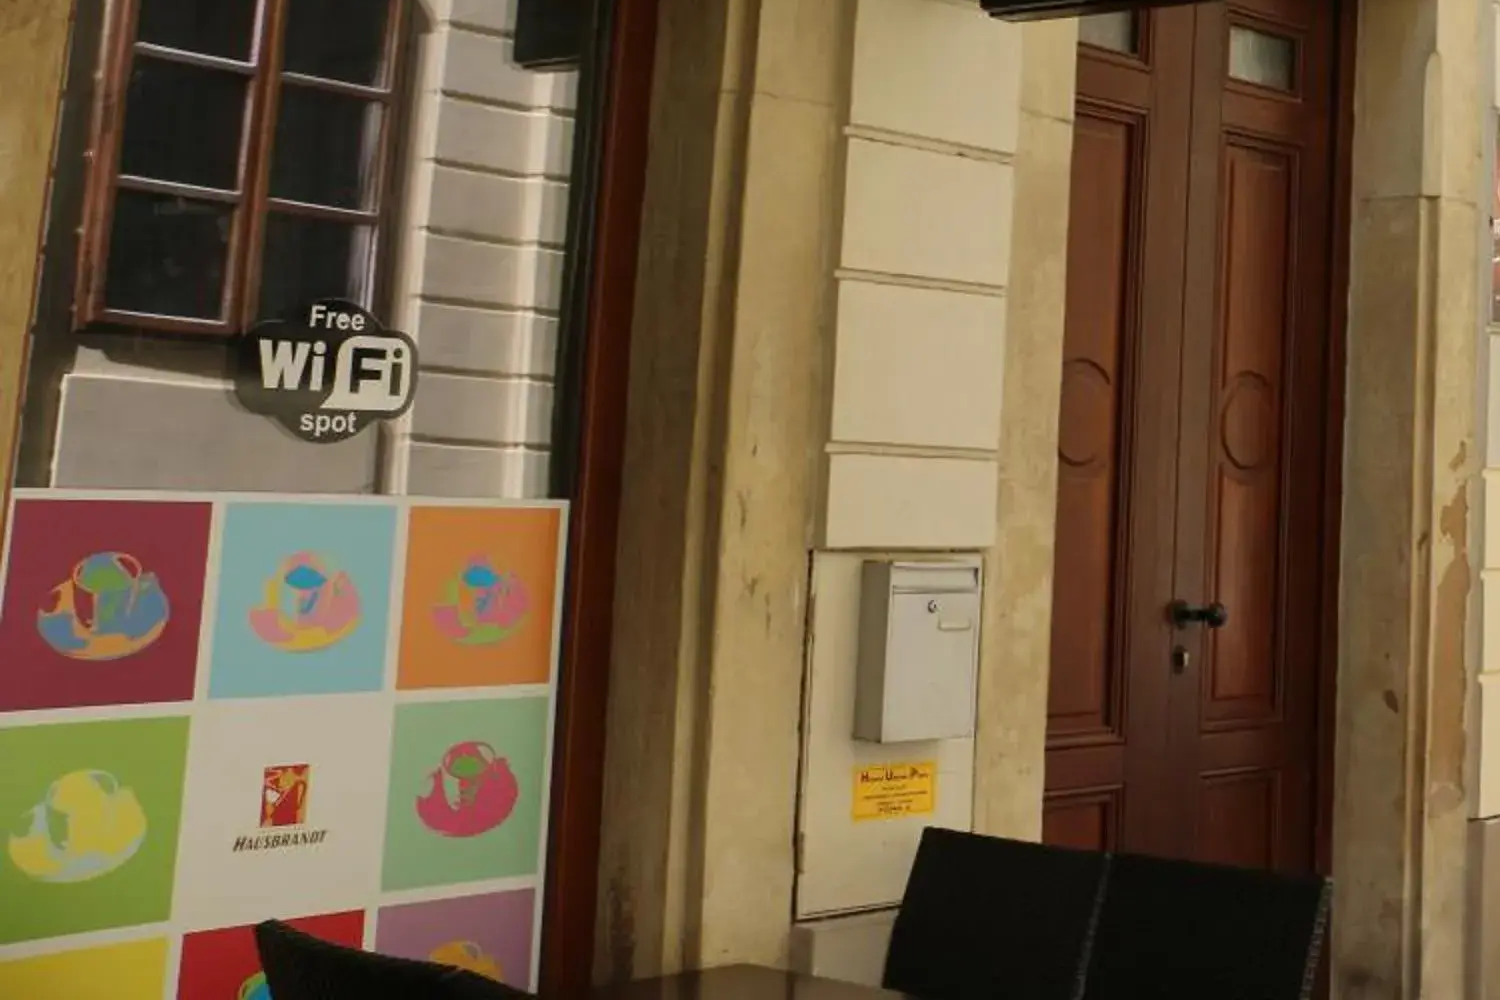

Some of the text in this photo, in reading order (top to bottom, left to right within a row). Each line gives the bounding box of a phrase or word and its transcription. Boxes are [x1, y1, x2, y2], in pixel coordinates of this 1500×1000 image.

[309, 304, 365, 331] Free
[300, 412, 357, 437] spot
[233, 829, 328, 852] HAUSBRANDT
